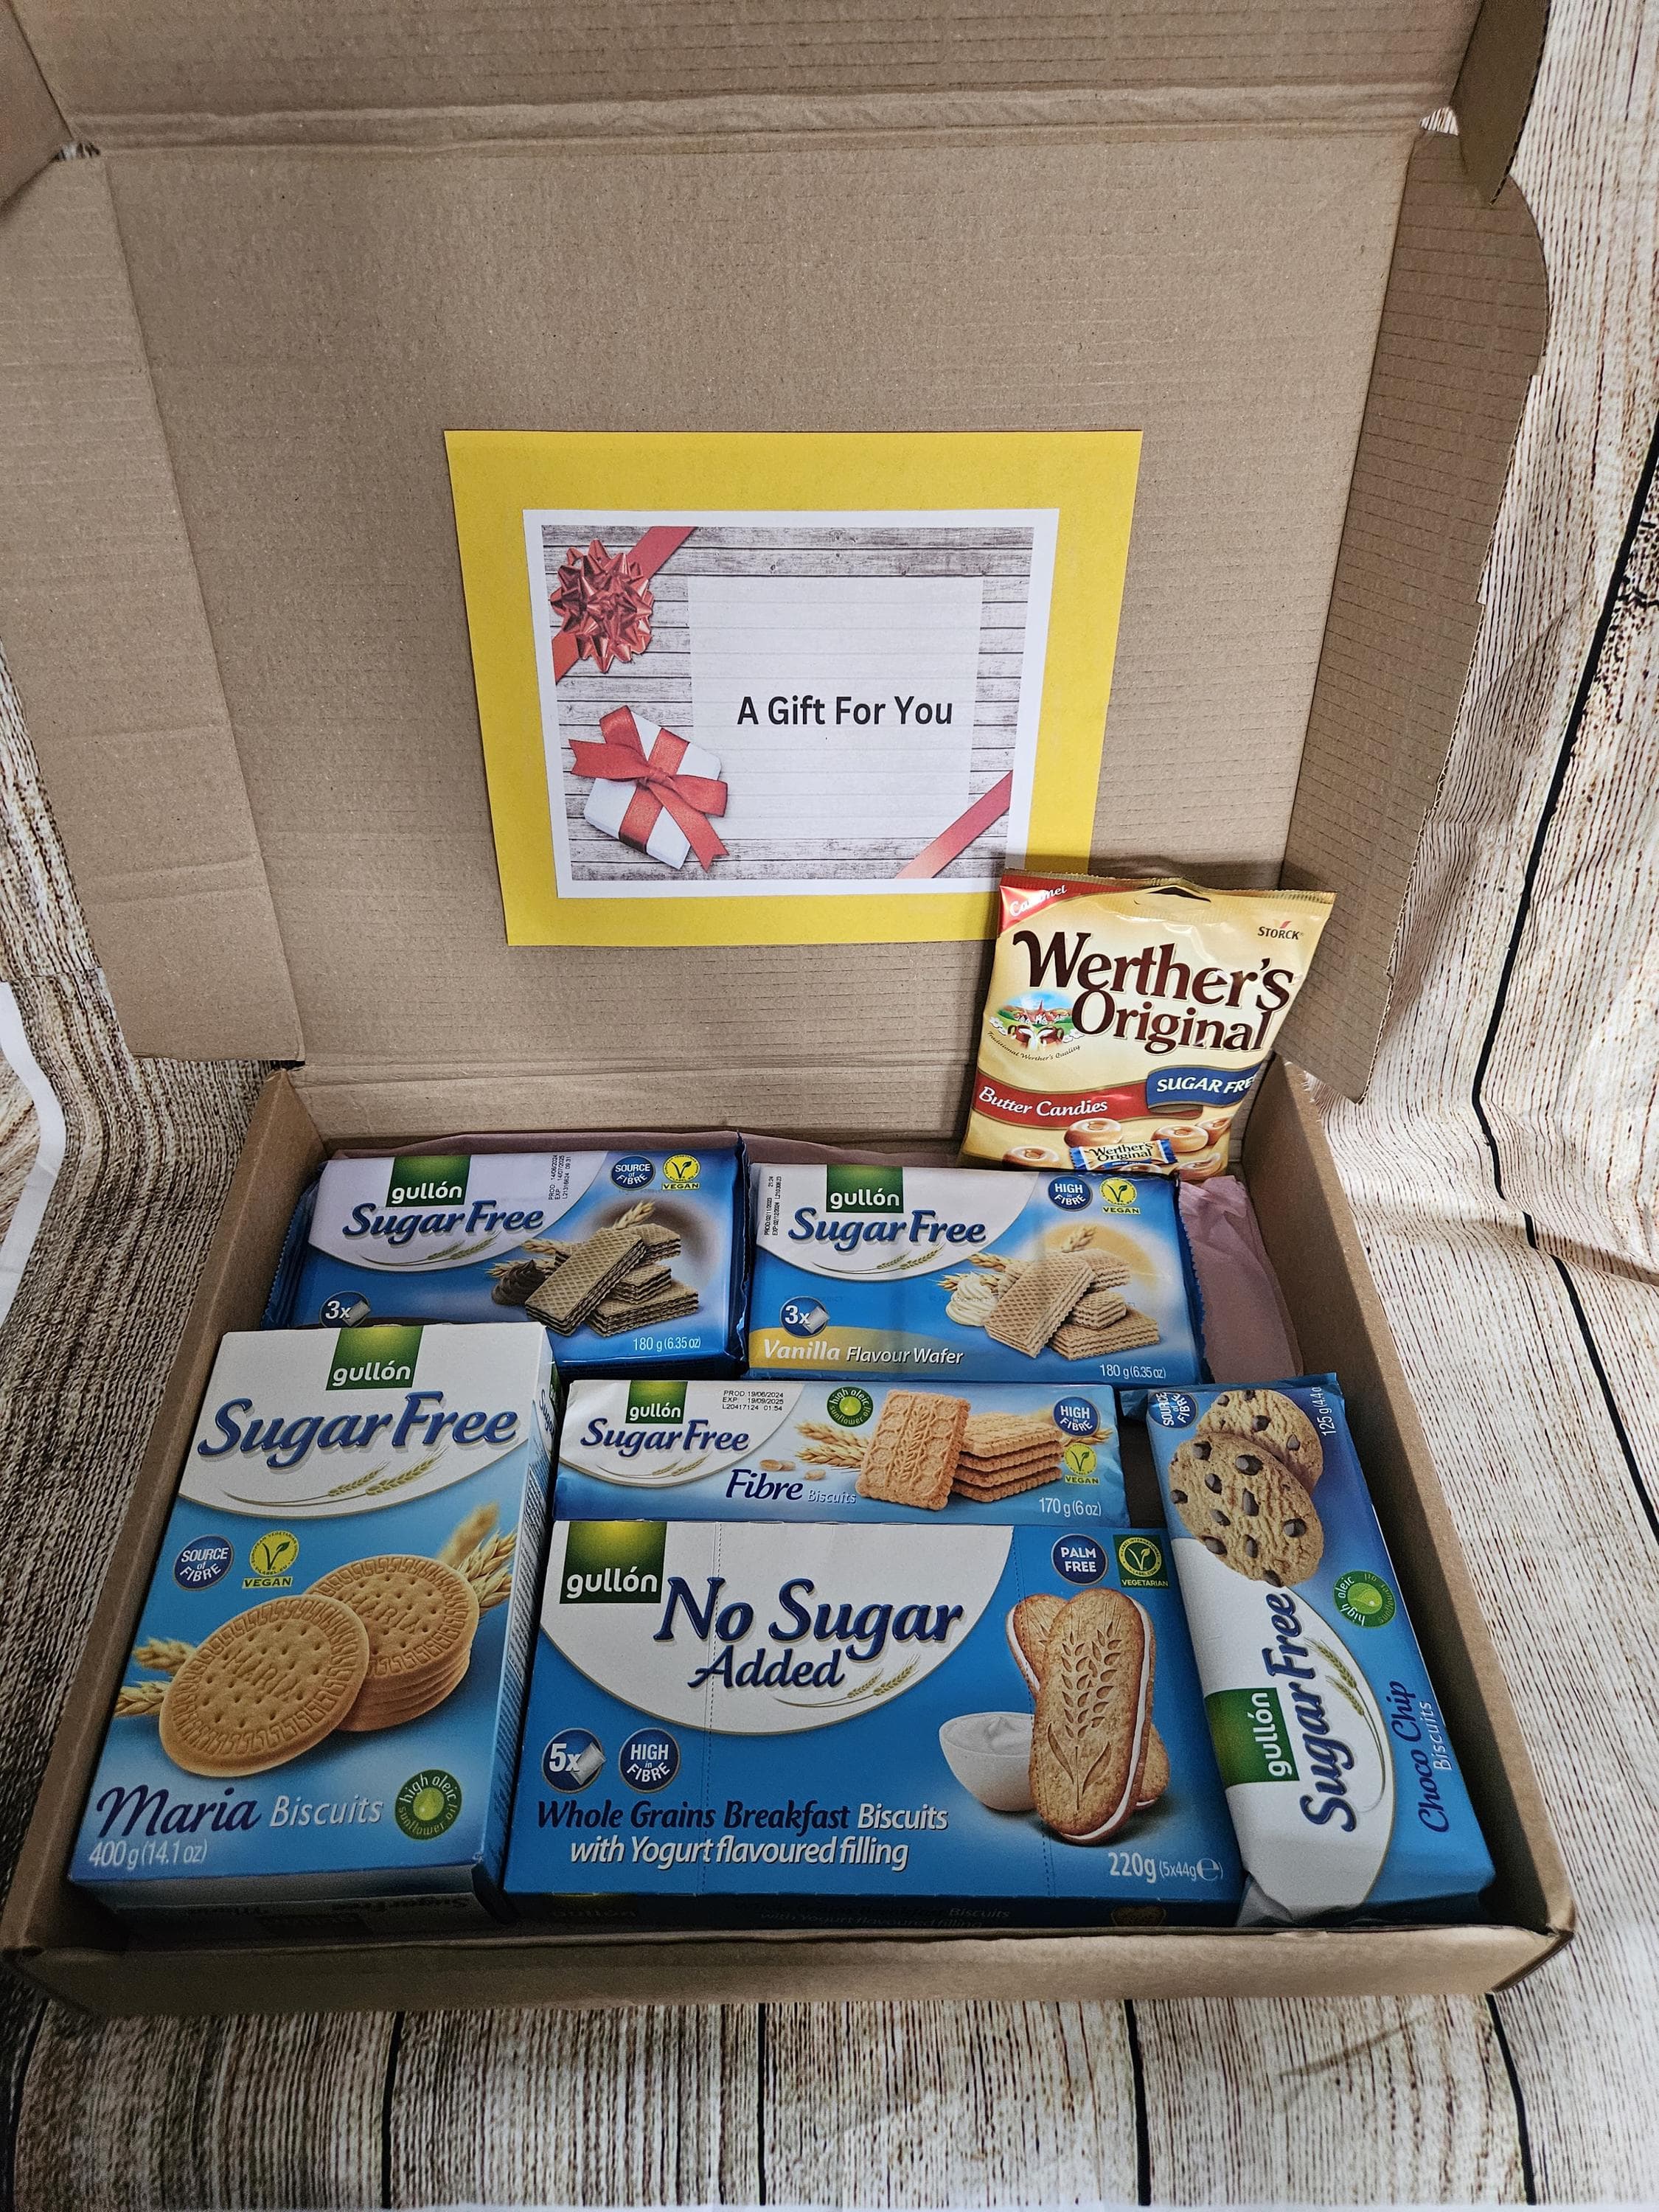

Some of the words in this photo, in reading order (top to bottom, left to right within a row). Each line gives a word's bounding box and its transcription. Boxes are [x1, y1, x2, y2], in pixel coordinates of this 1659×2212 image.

[737, 696, 759, 725] A
[768, 695, 825, 726] Gift
[835, 696, 886, 725] For
[894, 695, 953, 725] You
[1257, 926, 1300, 940] STORCK
[1012, 930, 1295, 1011] Werther's
[1072, 990, 1271, 1055] Original
[1156, 1077, 1223, 1093] SUGAR
[1223, 1074, 1257, 1093] FRE
[978, 1086, 1032, 1115] Butter
[1036, 1099, 1108, 1118] Candies
[1089, 1143, 1154, 1156] Werther's
[1097, 1150, 1152, 1162] Original
[615, 1164, 650, 1172] SOURCE
[616, 1173, 647, 1185] FIBRE
[392, 1179, 463, 1204] gullón
[830, 1182, 900, 1210] gullón
[1054, 1183, 1083, 1194] HIGH
[1054, 1194, 1086, 1206] FIBRE
[342, 1201, 464, 1245] Sugar
[464, 1200, 544, 1234] Free
[788, 1206, 907, 1252] Sugar
[908, 1208, 987, 1244] Free
[325, 1300, 351, 1320] 3x
[785, 1304, 810, 1324] 3x
[633, 1336, 654, 1352] 180
[664, 1336, 688, 1352] (6.35
[763, 1339, 841, 1362] Vanilla
[845, 1346, 910, 1366] Flavour
[914, 1347, 965, 1366] Wafer
[332, 1361, 410, 1387] gullón
[1099, 1363, 1121, 1377] 180
[1130, 1364, 1154, 1380] (6.35
[829, 1388, 848, 1405] high
[850, 1389, 869, 1405] oleic
[1155, 1391, 1175, 1426] SOURCE
[1171, 1393, 1190, 1424] FIBRE
[630, 1402, 682, 1421] gullón
[830, 1405, 863, 1425] sunflower
[1060, 1405, 1091, 1419] HIGH
[198, 1398, 392, 1469] Sugar
[392, 1391, 518, 1447] Free
[1060, 1417, 1093, 1432] FIBRE
[1316, 1416, 1337, 1436] 125
[580, 1418, 684, 1457] Sugar
[685, 1419, 749, 1451] Free
[726, 1468, 802, 1503] Fibre
[807, 1489, 857, 1505] Biscuits
[1065, 1475, 1099, 1484] VEGAN
[1039, 1498, 1061, 1514] 170
[1063, 1504, 1070, 1517] g
[181, 1547, 229, 1562] SOURCE
[1060, 1547, 1097, 1559] PALM
[179, 1563, 221, 1582] FIBRE
[197, 1562, 206, 1571] of
[1064, 1561, 1097, 1573] FREE
[244, 1577, 291, 1587] VEGAN
[566, 1570, 658, 1599] gullón
[1335, 1576, 1354, 1599] oleic
[653, 1576, 755, 1644] No
[768, 1577, 964, 1662] Sugar
[1340, 1603, 1365, 1627] high
[1262, 1592, 1316, 1680] Free
[688, 1647, 846, 1690] Added
[1386, 1680, 1423, 1742] Chip
[1251, 1691, 1293, 1777] gullón
[1422, 1700, 1453, 1771] Biscuits
[549, 1742, 582, 1773] 5x
[630, 1744, 669, 1761] HIGH
[644, 1760, 653, 1769] in
[1287, 1681, 1357, 1832] Sugar
[626, 1761, 670, 1783] FIBRE
[399, 1773, 428, 1804] high
[432, 1775, 457, 1801] oleic
[1409, 1748, 1450, 1834] Choco
[97, 1784, 262, 1838] Maria
[270, 1794, 384, 1829] Biscuits
[399, 1806, 445, 1835] sunflower
[445, 1804, 458, 1820] oil
[537, 1800, 624, 1830] Whole
[629, 1800, 715, 1830] Grains
[723, 1799, 849, 1835] Breakfast
[858, 1802, 949, 1831] Biscuits
[88, 1842, 128, 1867] 400
[570, 1835, 626, 1864] with
[631, 1837, 712, 1870] Yogurt
[714, 1834, 835, 1865] flavoured
[838, 1834, 909, 1871] filling
[1108, 1851, 1157, 1884] 220g
